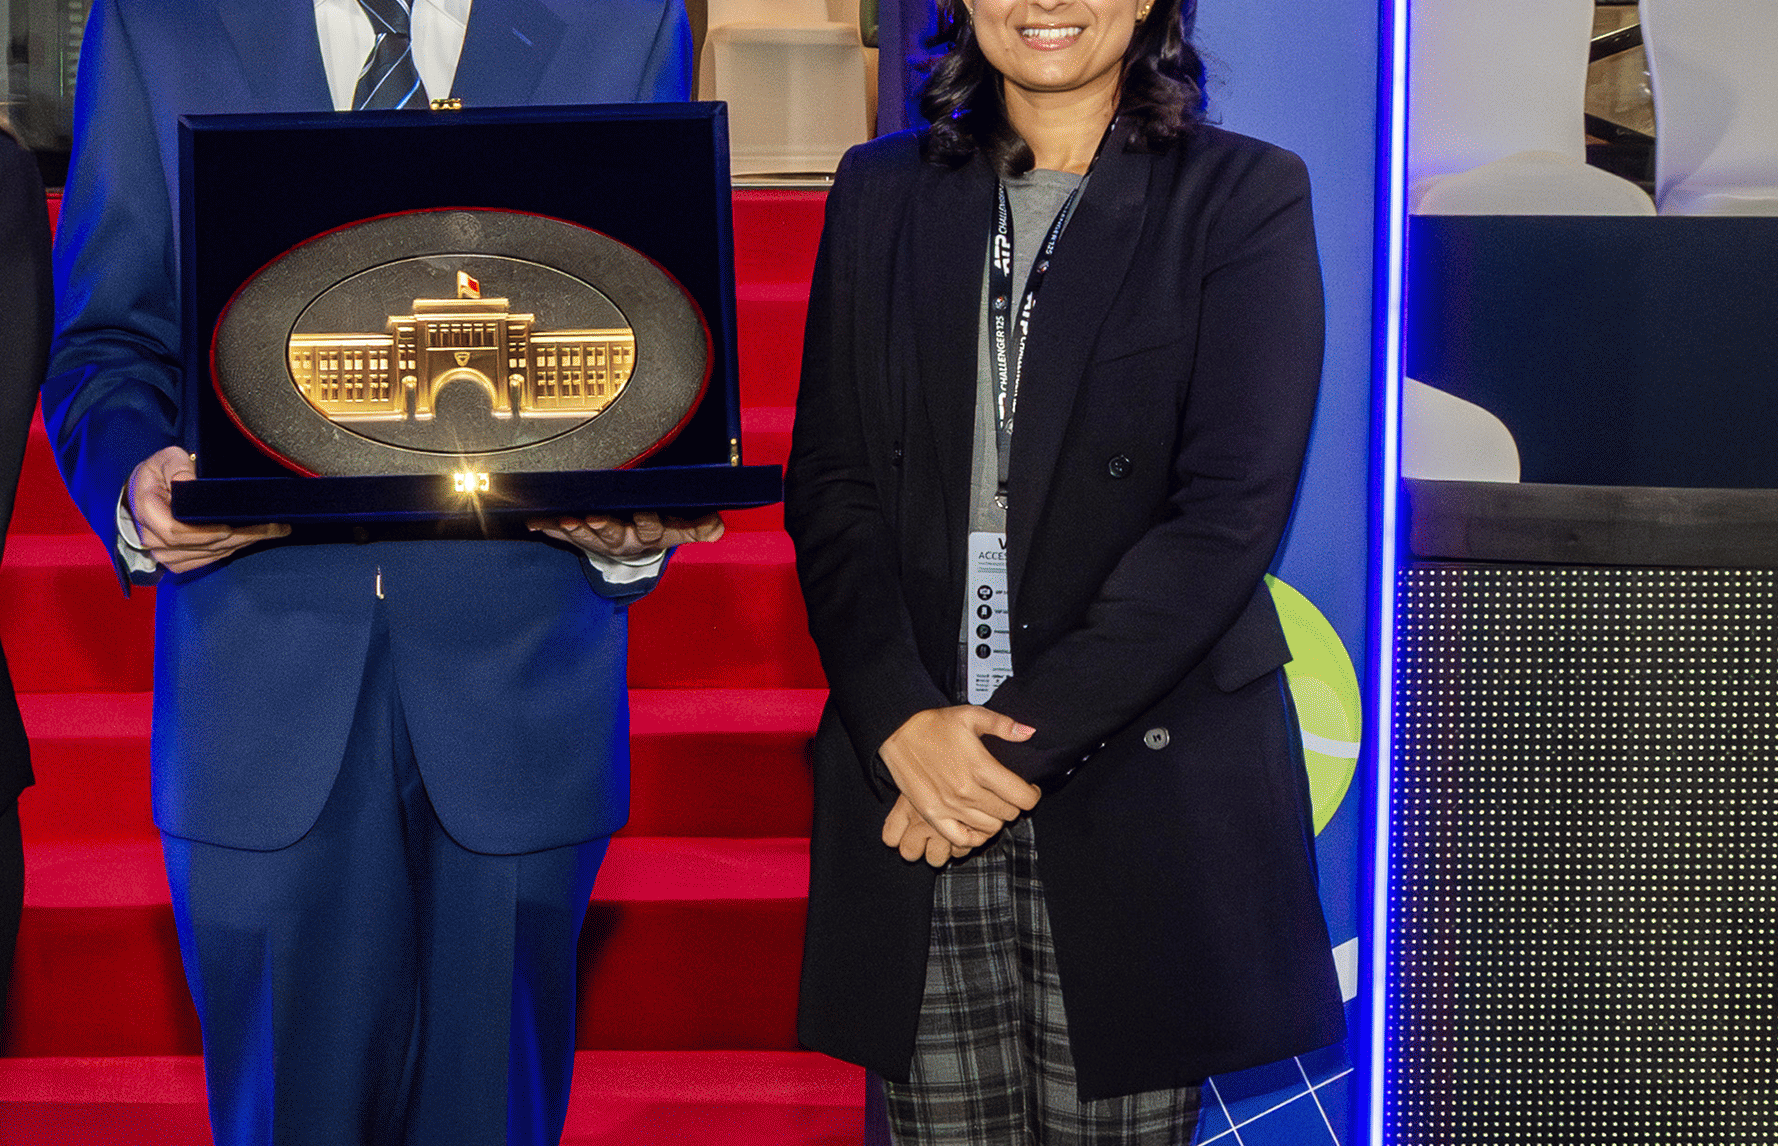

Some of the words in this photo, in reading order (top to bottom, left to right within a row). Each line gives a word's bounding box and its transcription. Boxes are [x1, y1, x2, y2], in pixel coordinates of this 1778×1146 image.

[994, 234, 1011, 277] ATP
[995, 315, 1005, 331] 125
[996, 331, 1008, 392] CHALLENGER
